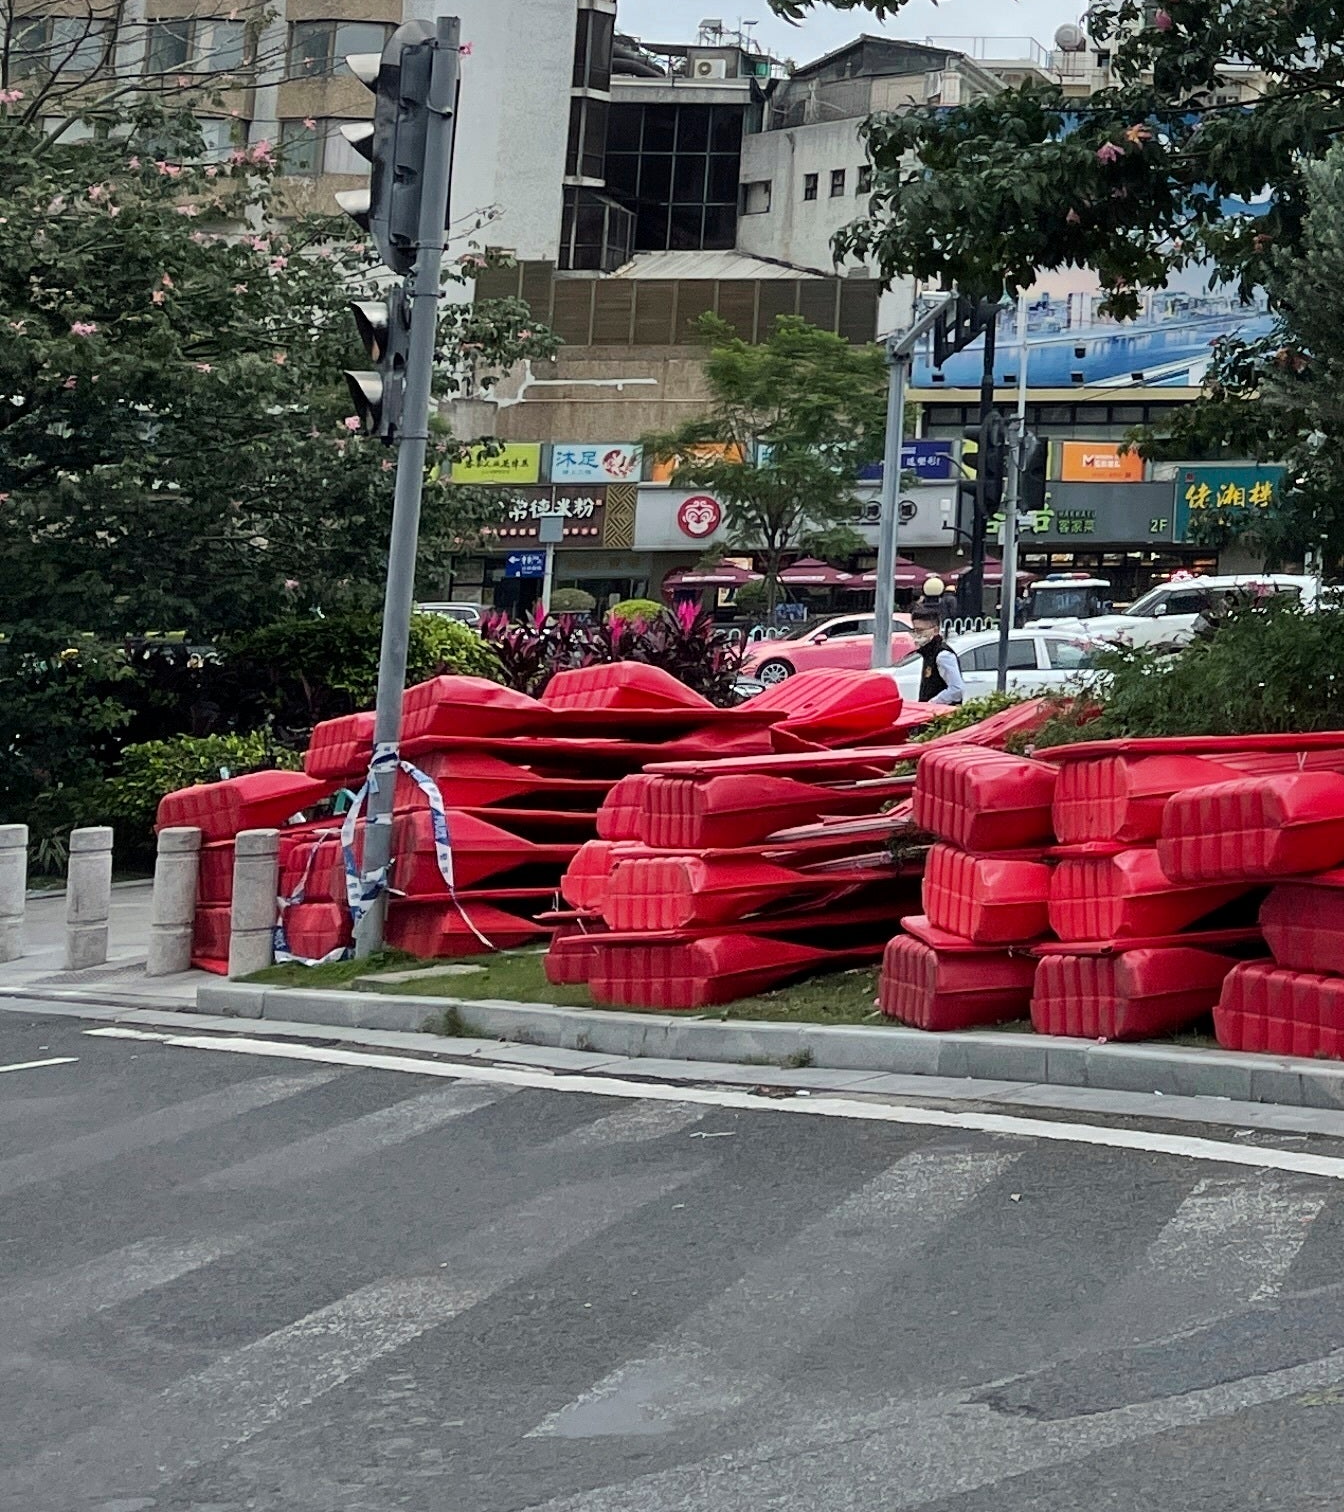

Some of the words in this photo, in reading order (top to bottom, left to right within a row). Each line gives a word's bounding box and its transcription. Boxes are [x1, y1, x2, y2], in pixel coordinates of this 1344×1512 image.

[555, 450, 600, 469] 沐足
[1058, 519, 1096, 534] 客家菜
[1150, 518, 1168, 534] 2F
